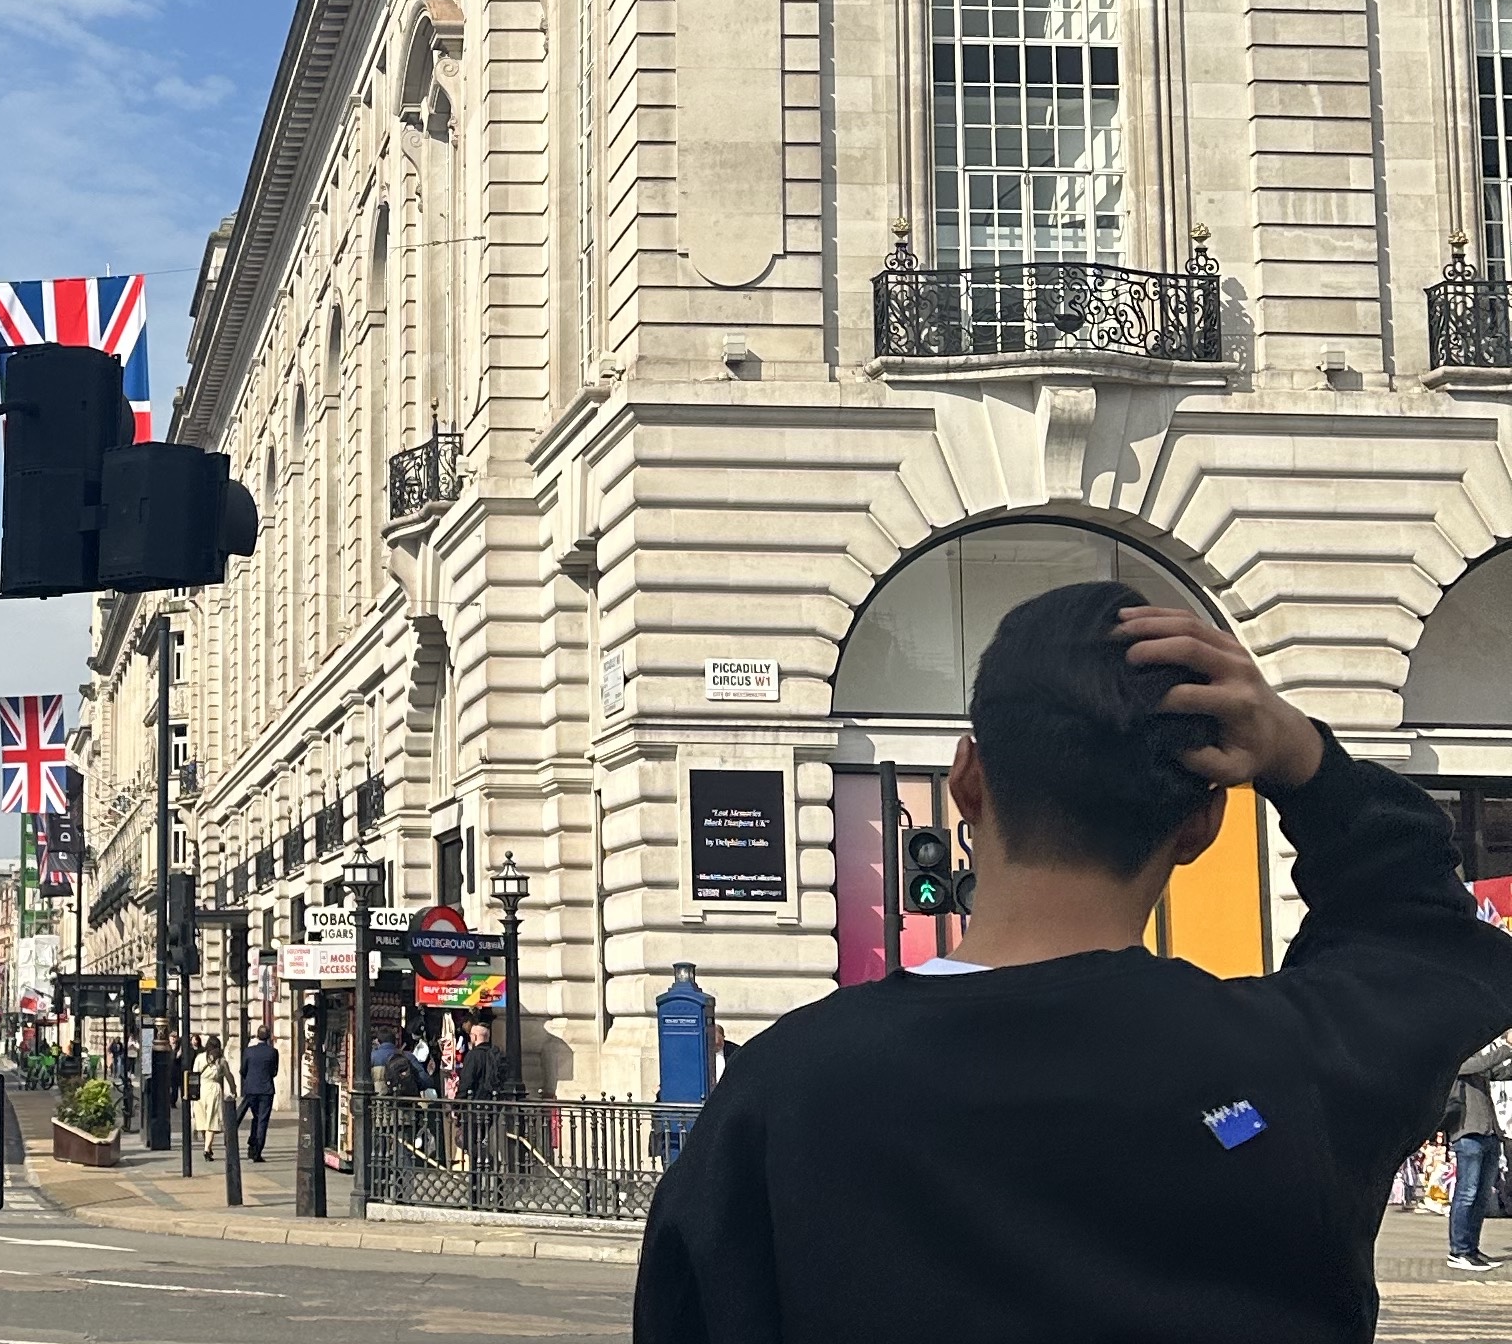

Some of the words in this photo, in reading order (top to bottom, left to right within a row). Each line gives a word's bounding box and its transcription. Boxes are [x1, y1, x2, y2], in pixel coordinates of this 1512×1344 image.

[712, 662, 772, 674] PICCADILLY
[712, 676, 752, 686] CIRCUS
[755, 676, 771, 687] W1
[729, 809, 762, 818] Memories
[705, 837, 714, 847] by
[320, 928, 354, 939] CIGARS
[375, 936, 400, 945] PUBLIC
[411, 937, 475, 950] UNDERGROUND
[478, 940, 504, 950] SUBWAY
[423, 986, 440, 994] BUY
[441, 987, 473, 995] TICKETS
